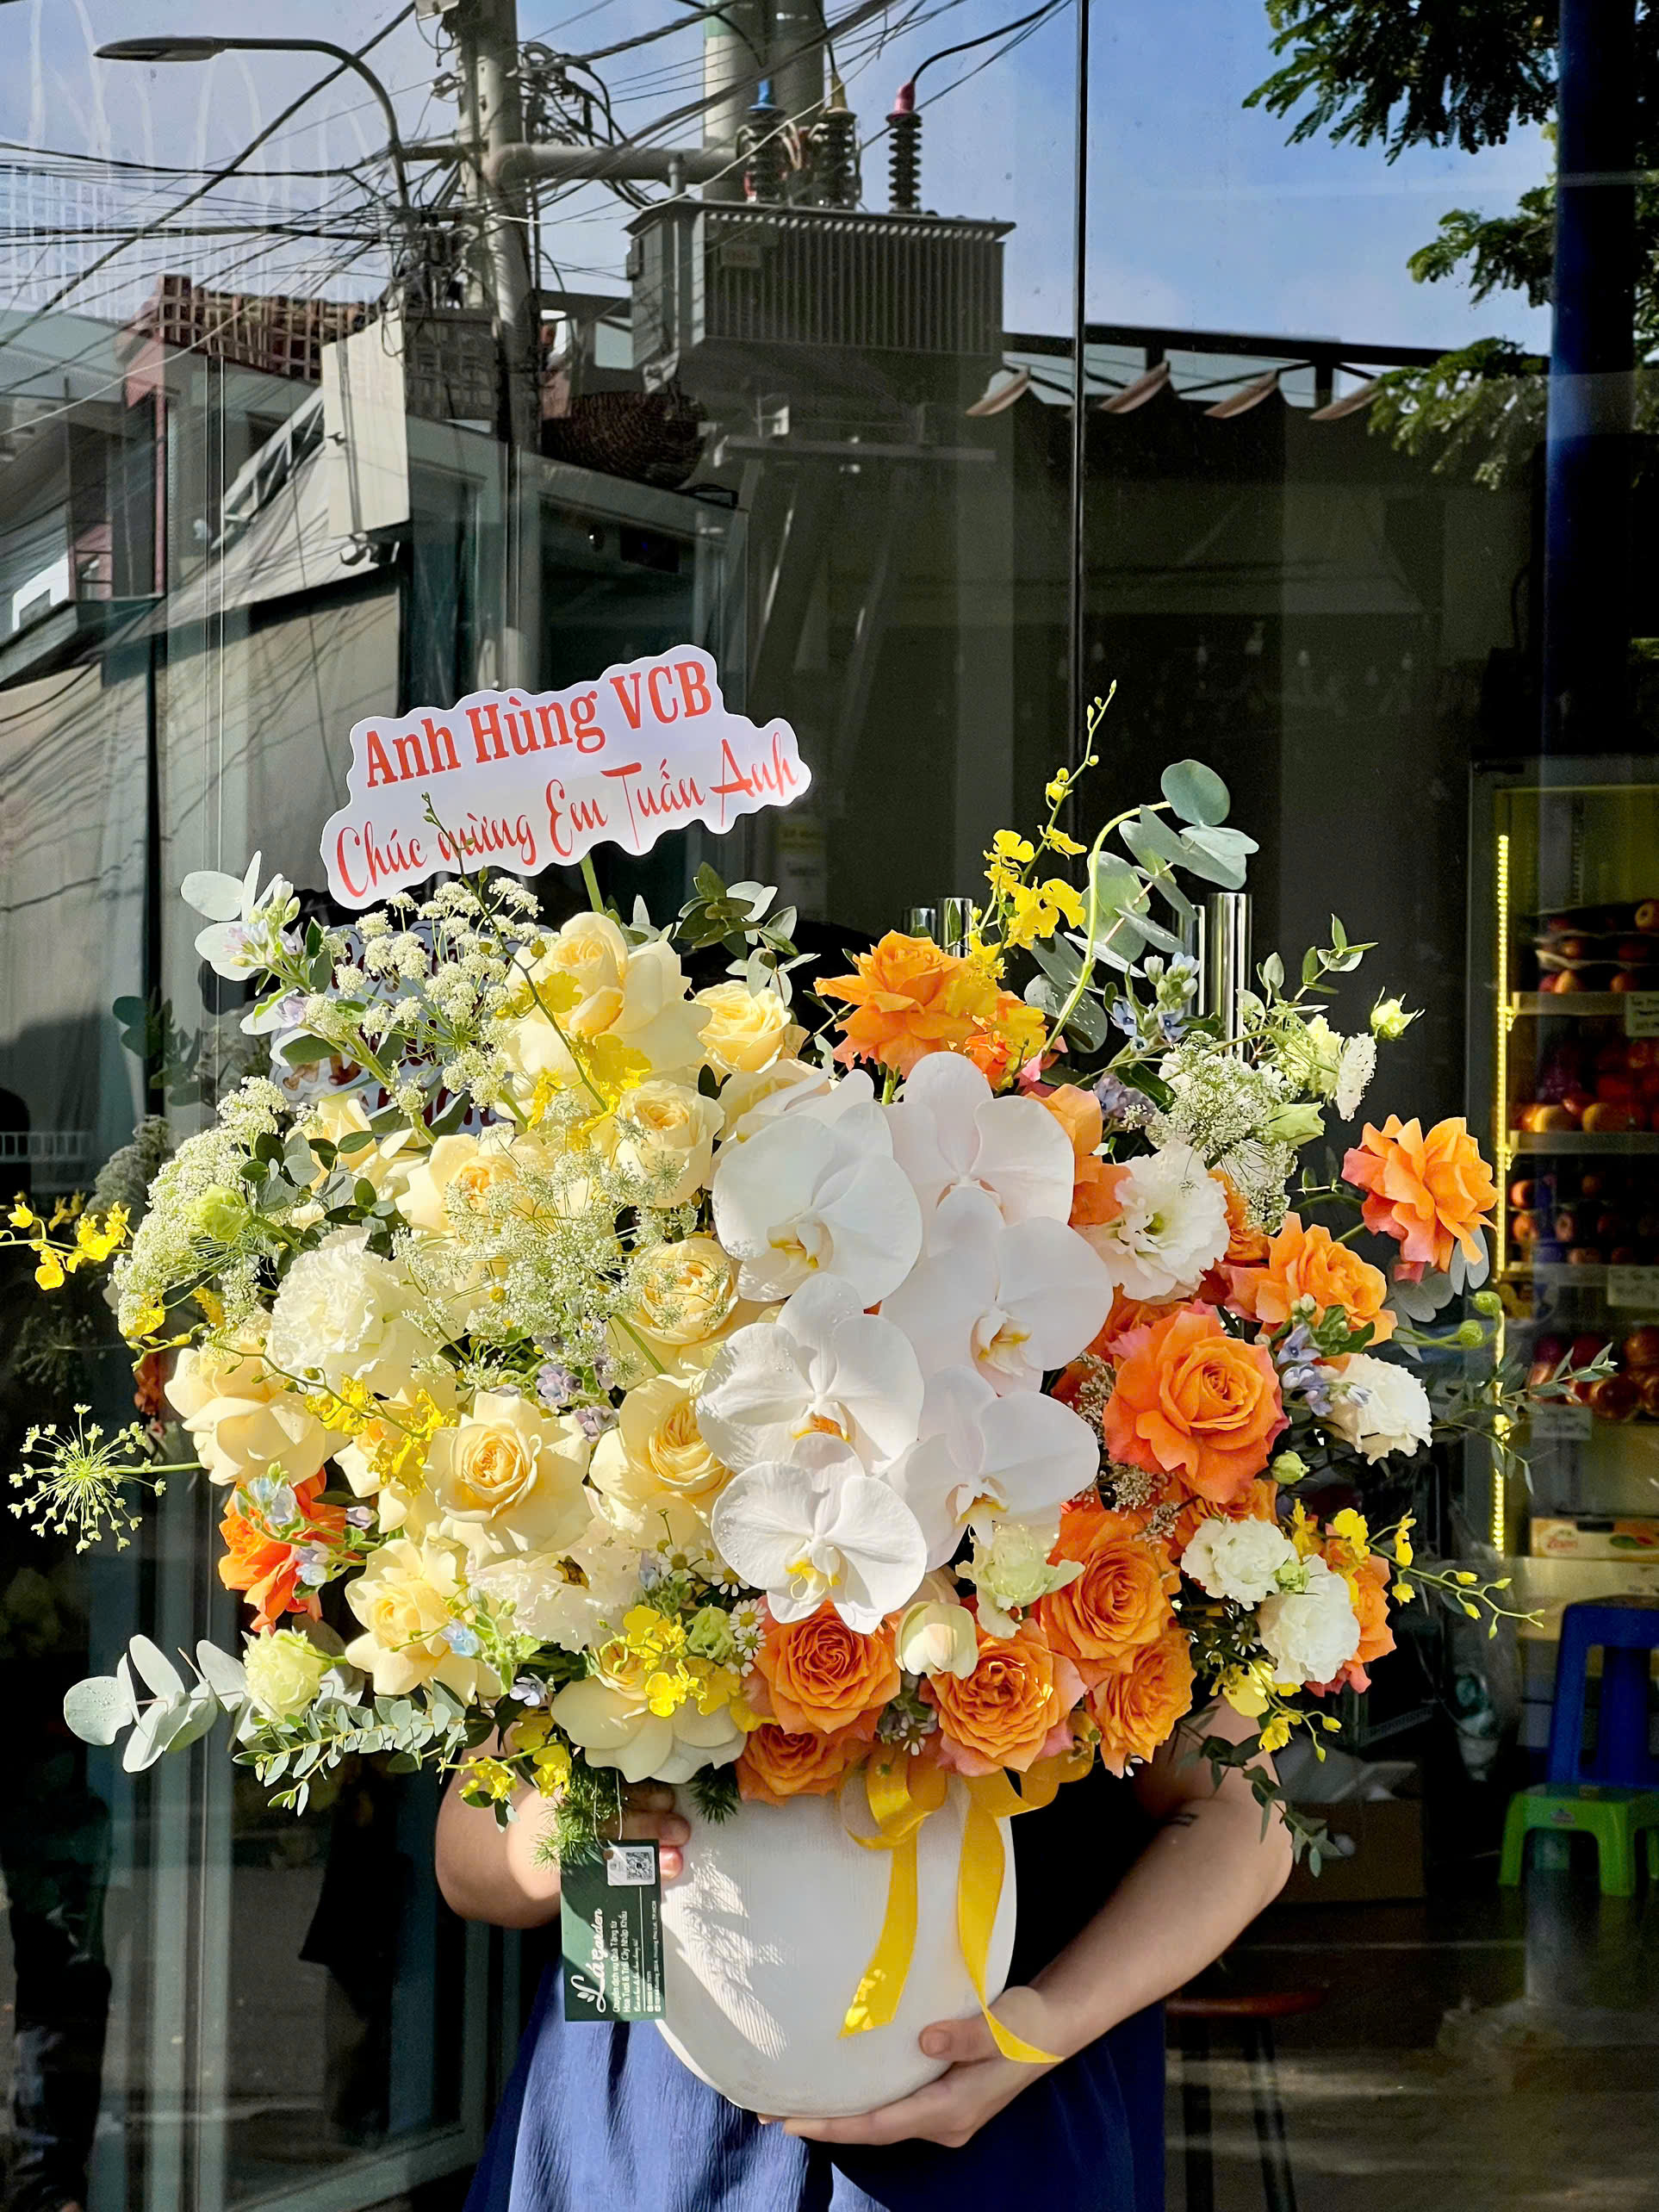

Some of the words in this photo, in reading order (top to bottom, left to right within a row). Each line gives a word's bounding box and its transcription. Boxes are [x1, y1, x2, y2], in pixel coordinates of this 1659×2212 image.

[366, 718, 463, 789] Anh
[465, 695, 607, 765] Hùng
[608, 661, 713, 730] VCB
[336, 820, 428, 898] Chúc
[437, 812, 538, 867] mừng
[545, 778, 608, 858] Em
[600, 758, 706, 850] Tuấn
[709, 731, 800, 828] Anh
[591, 1908, 608, 1961] Garden
